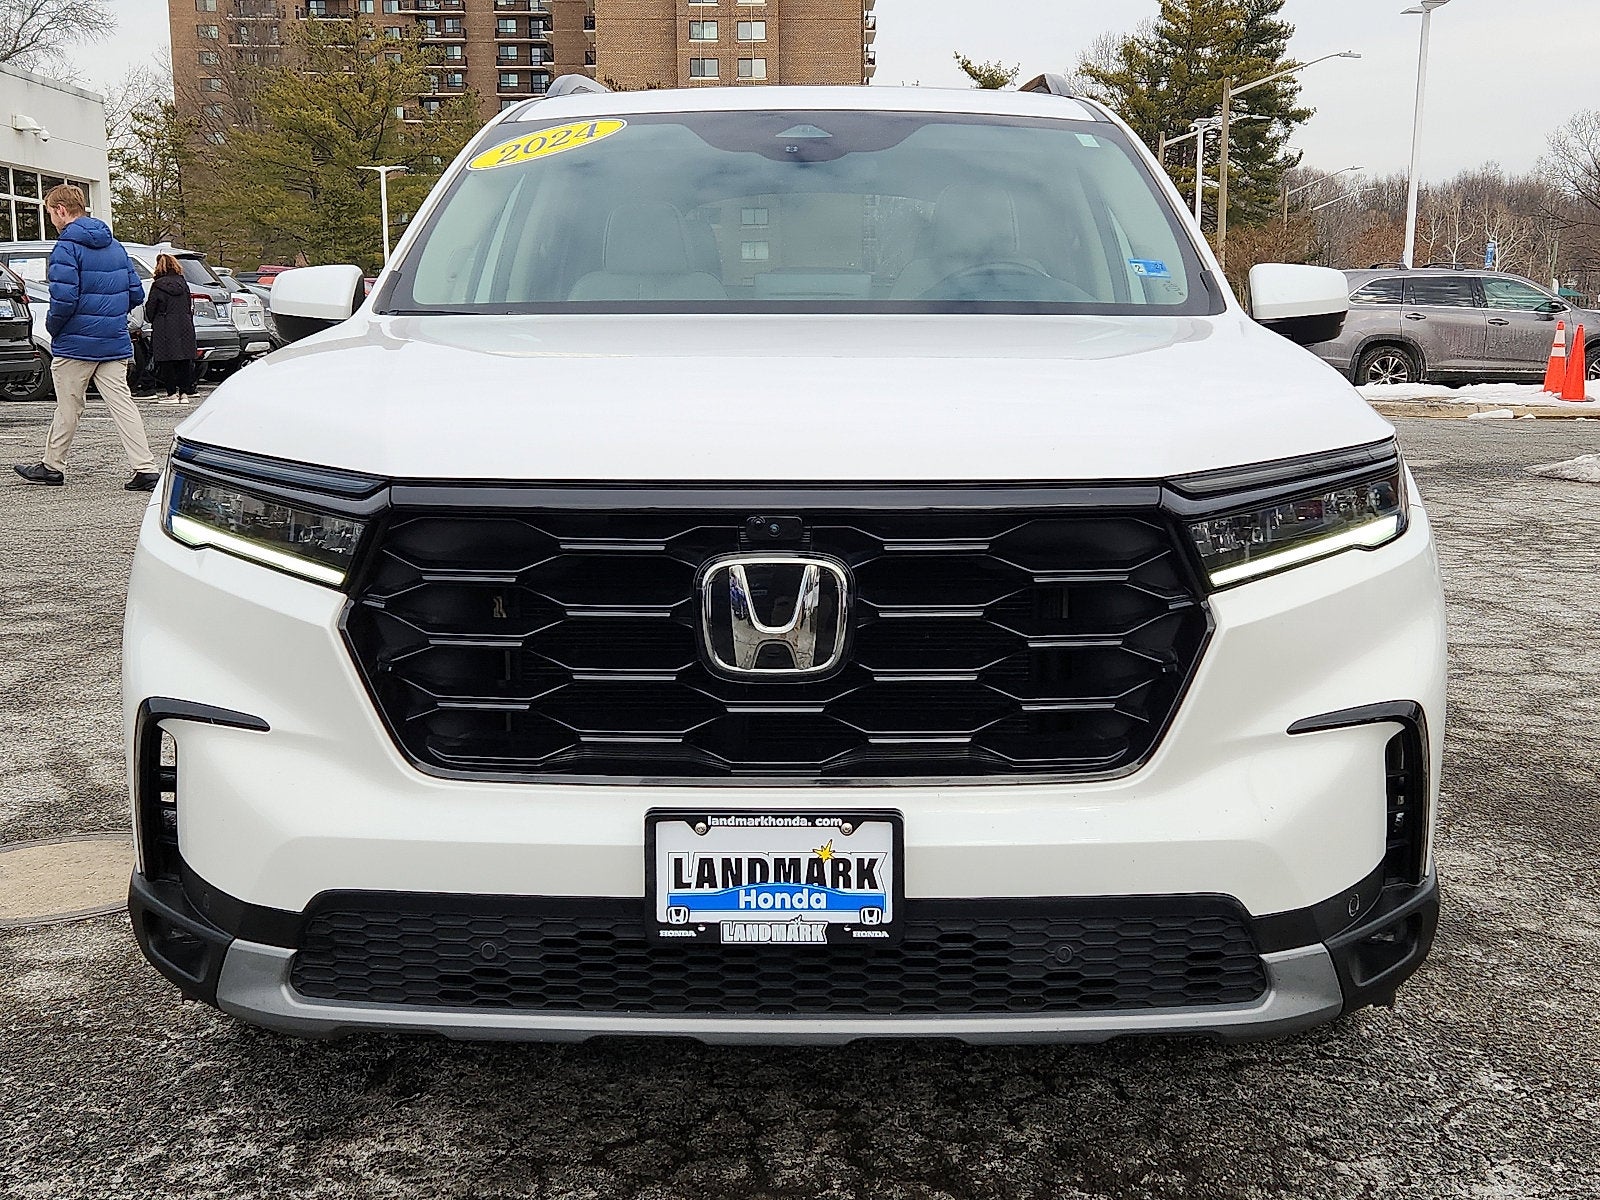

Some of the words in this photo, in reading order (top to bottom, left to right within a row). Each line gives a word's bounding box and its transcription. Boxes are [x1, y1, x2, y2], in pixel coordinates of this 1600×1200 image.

[497, 122, 598, 164] 2024
[673, 857, 879, 890] LANDMARK
[739, 889, 827, 909] Honda
[722, 922, 826, 941] LANDMARK
